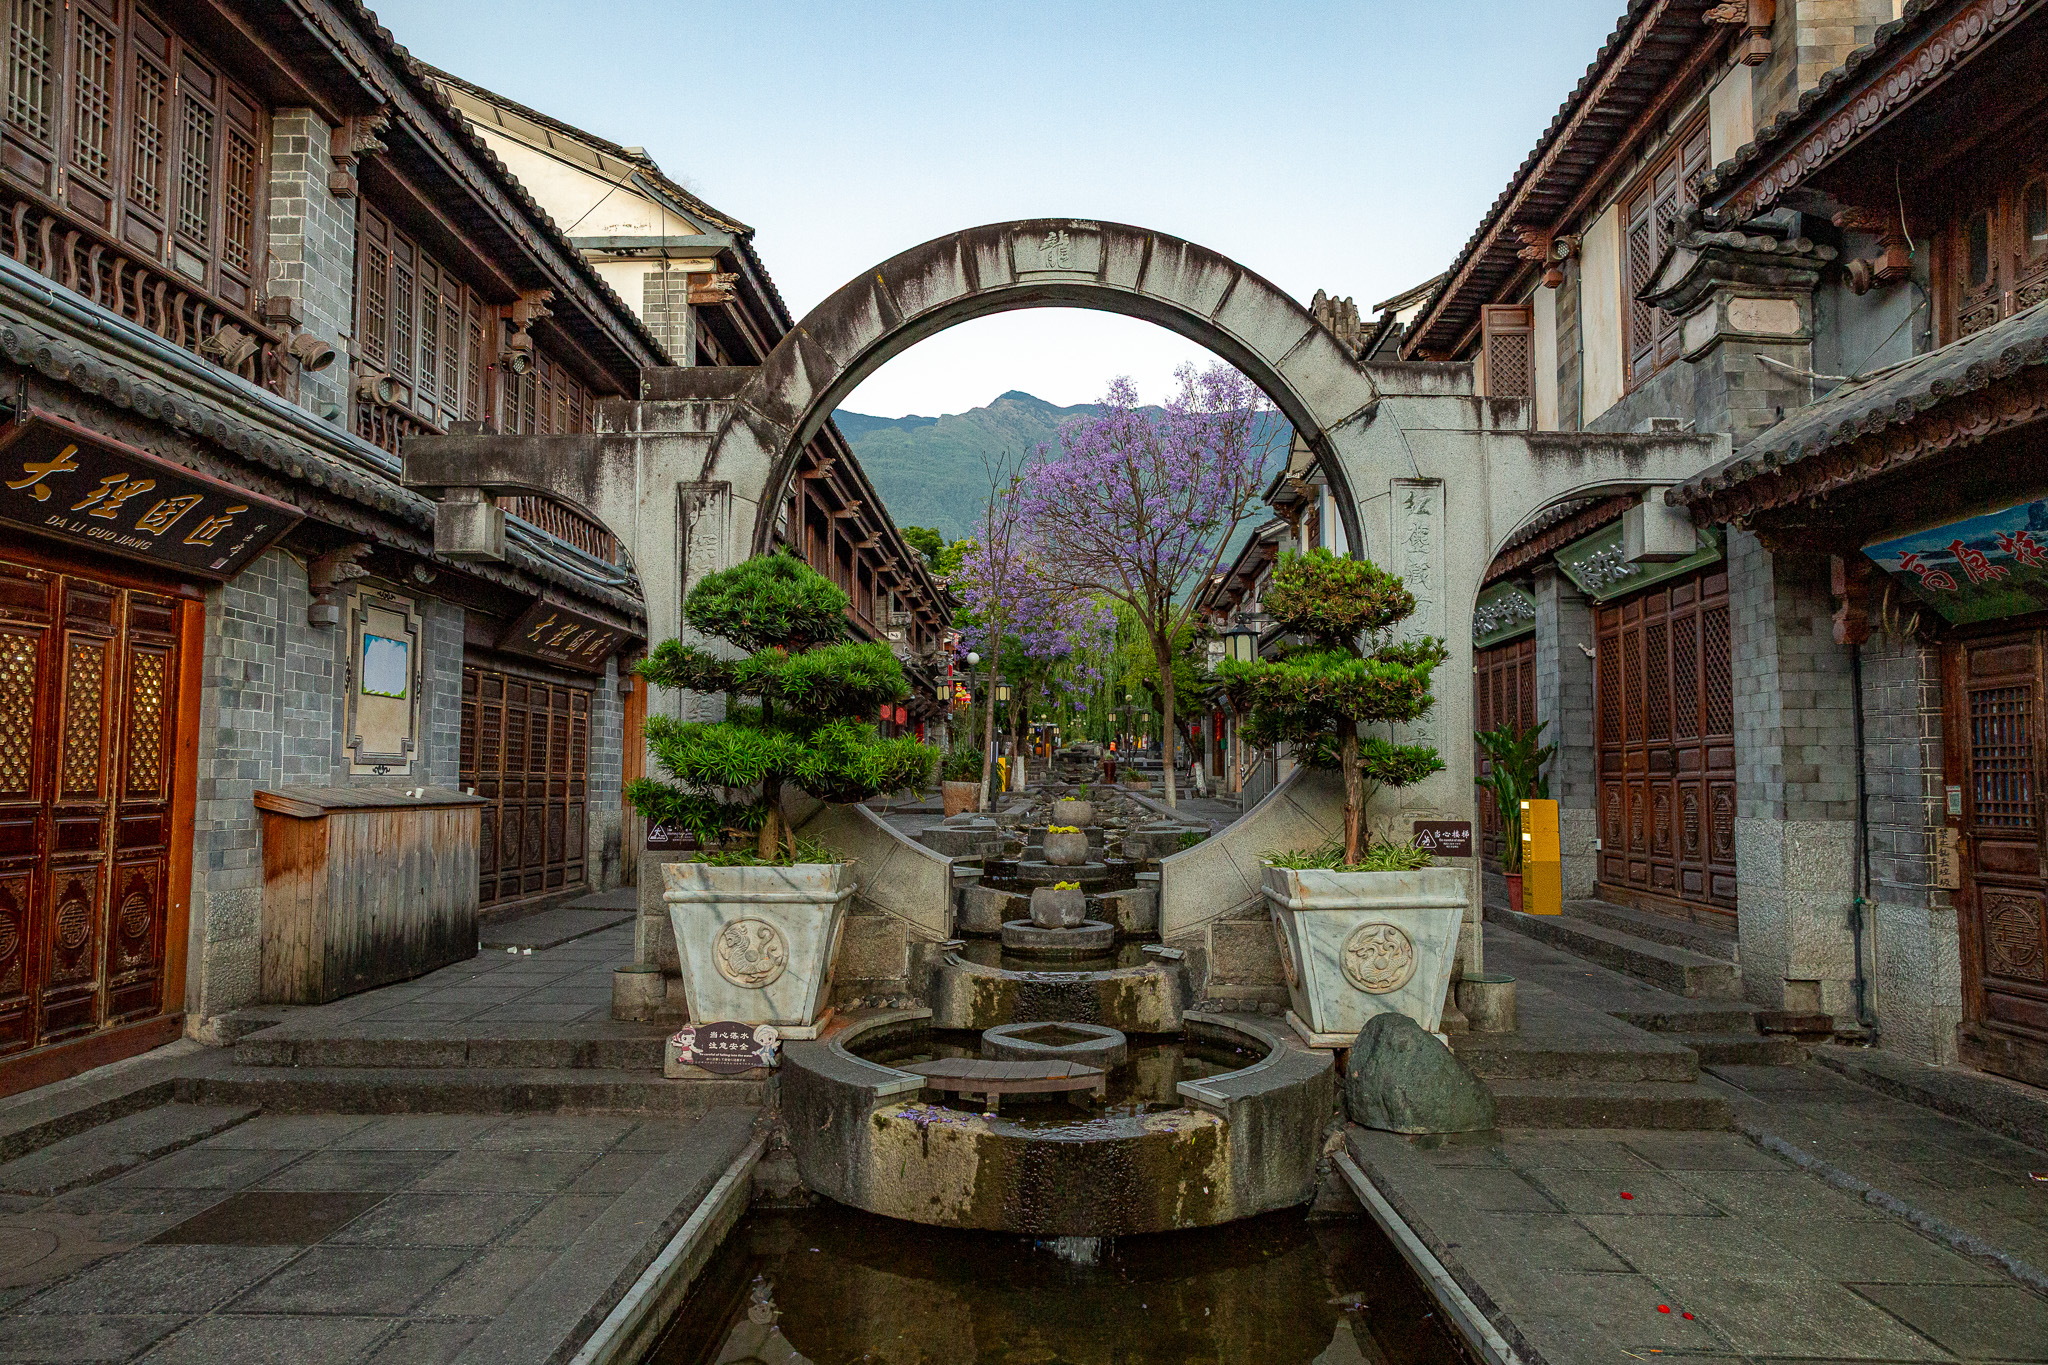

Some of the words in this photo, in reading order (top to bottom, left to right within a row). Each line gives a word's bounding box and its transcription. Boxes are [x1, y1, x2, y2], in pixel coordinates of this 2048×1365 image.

[44, 515, 68, 528] DA
[68, 521, 88, 533] LI
[86, 526, 118, 541] GUO
[114, 534, 153, 550] JIANG
[1434, 829, 1470, 839] 当心楼梯
[709, 1031, 750, 1040] 当心落水
[708, 1041, 749, 1051] 注意安全
